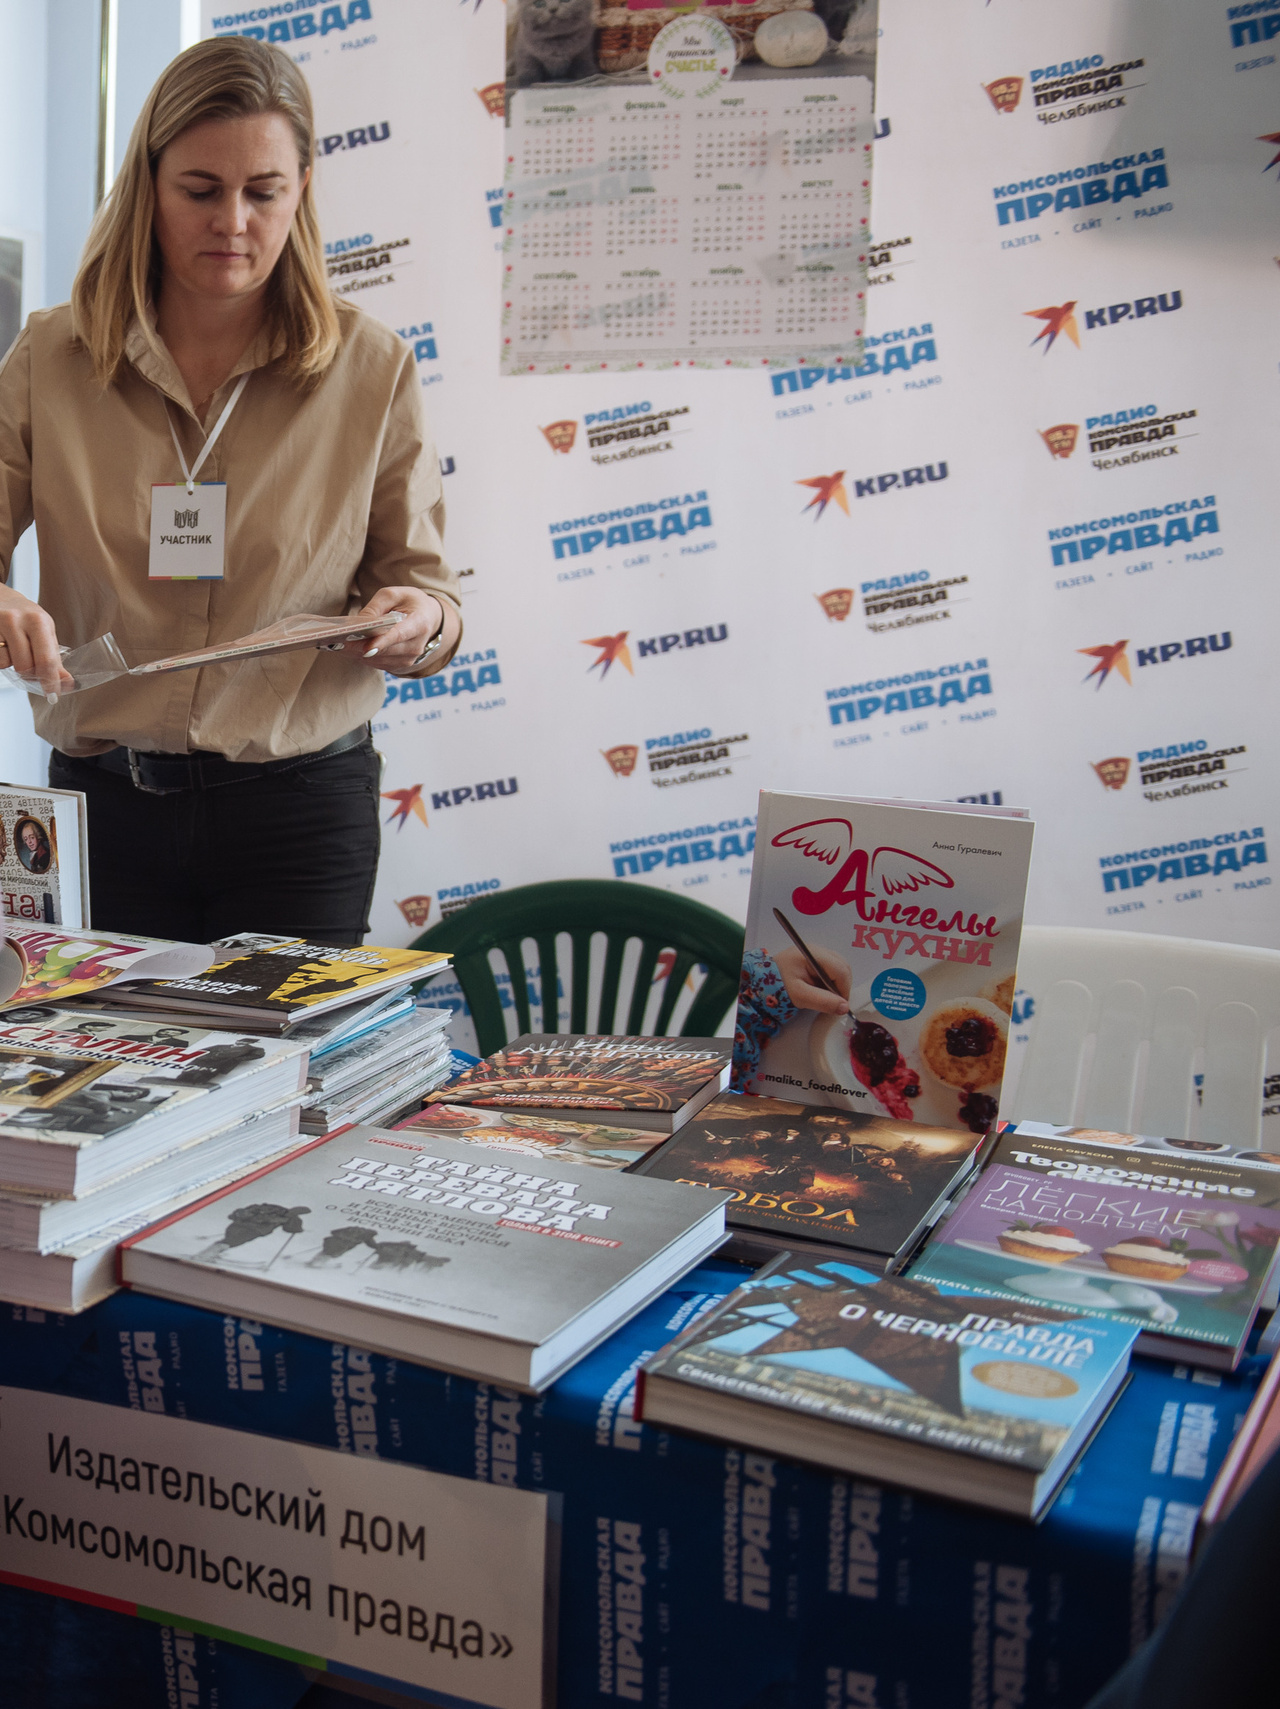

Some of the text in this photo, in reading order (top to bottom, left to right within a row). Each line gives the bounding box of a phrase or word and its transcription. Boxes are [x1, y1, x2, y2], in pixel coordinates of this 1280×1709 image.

[212, 0, 340, 28] КОМСОМОЛЬ
[215, 0, 373, 43] РАВДА
[665, 59, 717, 74] СЧАСТЬЕ
[1030, 54, 1104, 83] РАДИО
[1032, 58, 1145, 93] КОМСОМОЛЬСКАЯ
[1034, 74, 1123, 107] ПРАВДА
[1037, 96, 1126, 125] Челябинск
[993, 147, 1165, 198] КОМСОМОЛЬСКАЯ
[996, 164, 1169, 226] ПРАВДА
[325, 233, 374, 255] АДИО
[327, 252, 392, 278] РАВДА
[1085, 290, 1183, 330] KP.RU
[583, 401, 652, 425] РАДИО
[1085, 404, 1158, 430] РАДИО
[1088, 409, 1197, 440] КОМСОМОЛЬСКАЯ
[589, 420, 670, 448] ПРАВДА
[1090, 424, 1176, 453] ПРАВДА
[1092, 445, 1179, 471] Челябинск
[855, 461, 948, 497] KP.RU
[549, 490, 708, 534] КОМСОМОЛЬСКАЯ
[1048, 495, 1216, 540] КОМСОМОЛЬСКАЯ
[160, 535, 212, 545] УЧАСТНИК
[552, 505, 712, 560] ПРАВДА
[1051, 510, 1220, 566] ПРАВДА
[860, 570, 930, 594] РАДИО
[865, 589, 948, 616] ПРАВДА
[637, 622, 729, 657] KP.RU
[1136, 631, 1233, 667] KP.RU
[382, 664, 501, 708] РАВДА
[825, 657, 988, 700] КОМСОМОЛЬСКАЯ
[828, 673, 992, 725] ПРАВДА
[645, 727, 712, 750] РАДИО
[1137, 739, 1207, 763] РАДИО
[649, 746, 730, 772] ПРАВДА
[1141, 759, 1225, 785] ПРАВДА
[431, 776, 519, 809] KP.RU
[1144, 779, 1228, 802] Челябинск
[932, 841, 1002, 857] Анна Гуралевич
[1099, 826, 1264, 868] КОМСОМОЛЬСКАЯ
[1102, 841, 1268, 893] ПРАВДА
[437, 878, 500, 900] РАДИО
[791, 849, 1001, 937] Ангелы
[756, 1071, 868, 1099] @malika_foodflover
[1031, 1143, 1115, 1160] ЕЛЕНА ОБУХОВА
[338, 1156, 616, 1221] ПЕРЕВАЛА
[412, 1153, 582, 1197] ТАЙНА
[1010, 1150, 1256, 1198] Творожные
[327, 1171, 580, 1232] ДЯТЛОВА
[365, 1199, 501, 1232] ВСЕ ДОКУМЕНТЫ
[980, 1192, 1189, 1239] НА ПОДЪЁМ
[989, 1178, 1208, 1229] ЛЁГКИЕ
[340, 1207, 400, 1226] САМОЙ
[400, 1219, 511, 1248] ЗАГАДОЧНОЙ
[346, 1215, 466, 1247] ИСТОРИИ ВЕКА
[360, 1204, 437, 1227] ГЛАВНЫЕ
[437, 1222, 504, 1240] ВЕРСИИ
[500, 1219, 541, 1233] ТОЛЬКО
[552, 1228, 582, 1242] ЭТОЙ
[581, 1236, 619, 1248] КНИГЕ
[913, 1274, 971, 1293] СЧИТАТЬ
[1051, 1303, 1077, 1315] ЭТО
[1081, 1308, 1109, 1320] ТАК
[838, 1304, 1092, 1369] О ЧЕРНОБЫЛЕ
[960, 1312, 1096, 1356] ПРАВДА
[133, 1331, 165, 1412] ВДА
[274, 1351, 287, 1393] ГАЗЕТА
[347, 1345, 379, 1456] АВДА
[46, 1431, 427, 1563] Издательский дом
[723, 1448, 741, 1603] КОМСОМОЛЬСК
[741, 1454, 777, 1611] ПРАВД
[846, 1482, 881, 1599] ПРА
[326, 1583, 514, 1661] правда»
[596, 1516, 613, 1694] КОМСОМОЛЬСКАЯ
[613, 1520, 647, 1701] ПРАВДА
[993, 1564, 1033, 1709] АВДА
